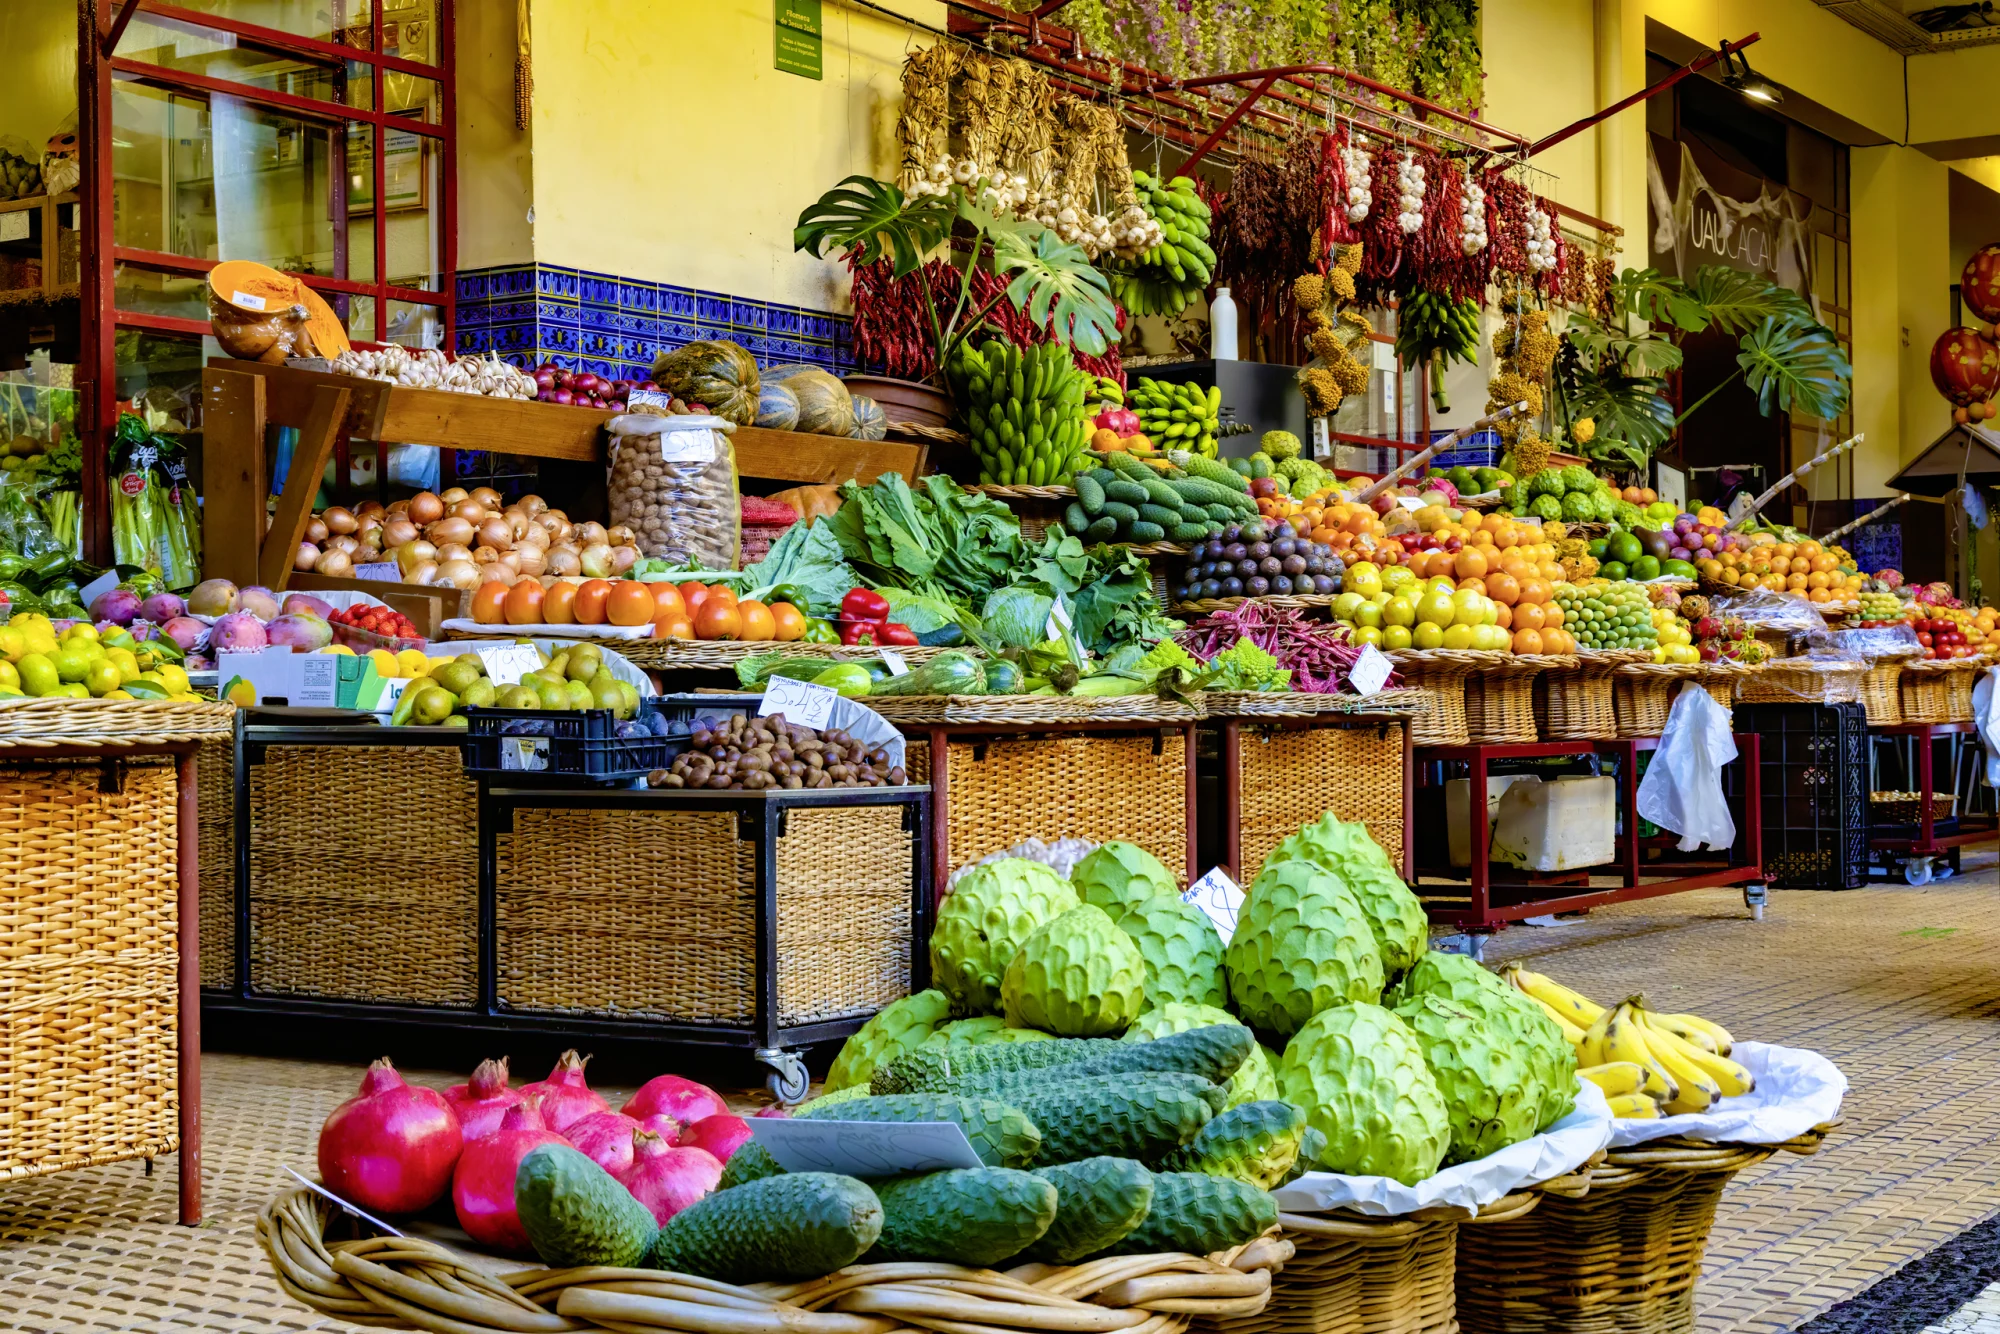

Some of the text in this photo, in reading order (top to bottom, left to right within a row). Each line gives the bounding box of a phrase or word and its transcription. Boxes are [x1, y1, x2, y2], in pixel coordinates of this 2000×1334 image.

[780, 17, 817, 33] de Jesus João
